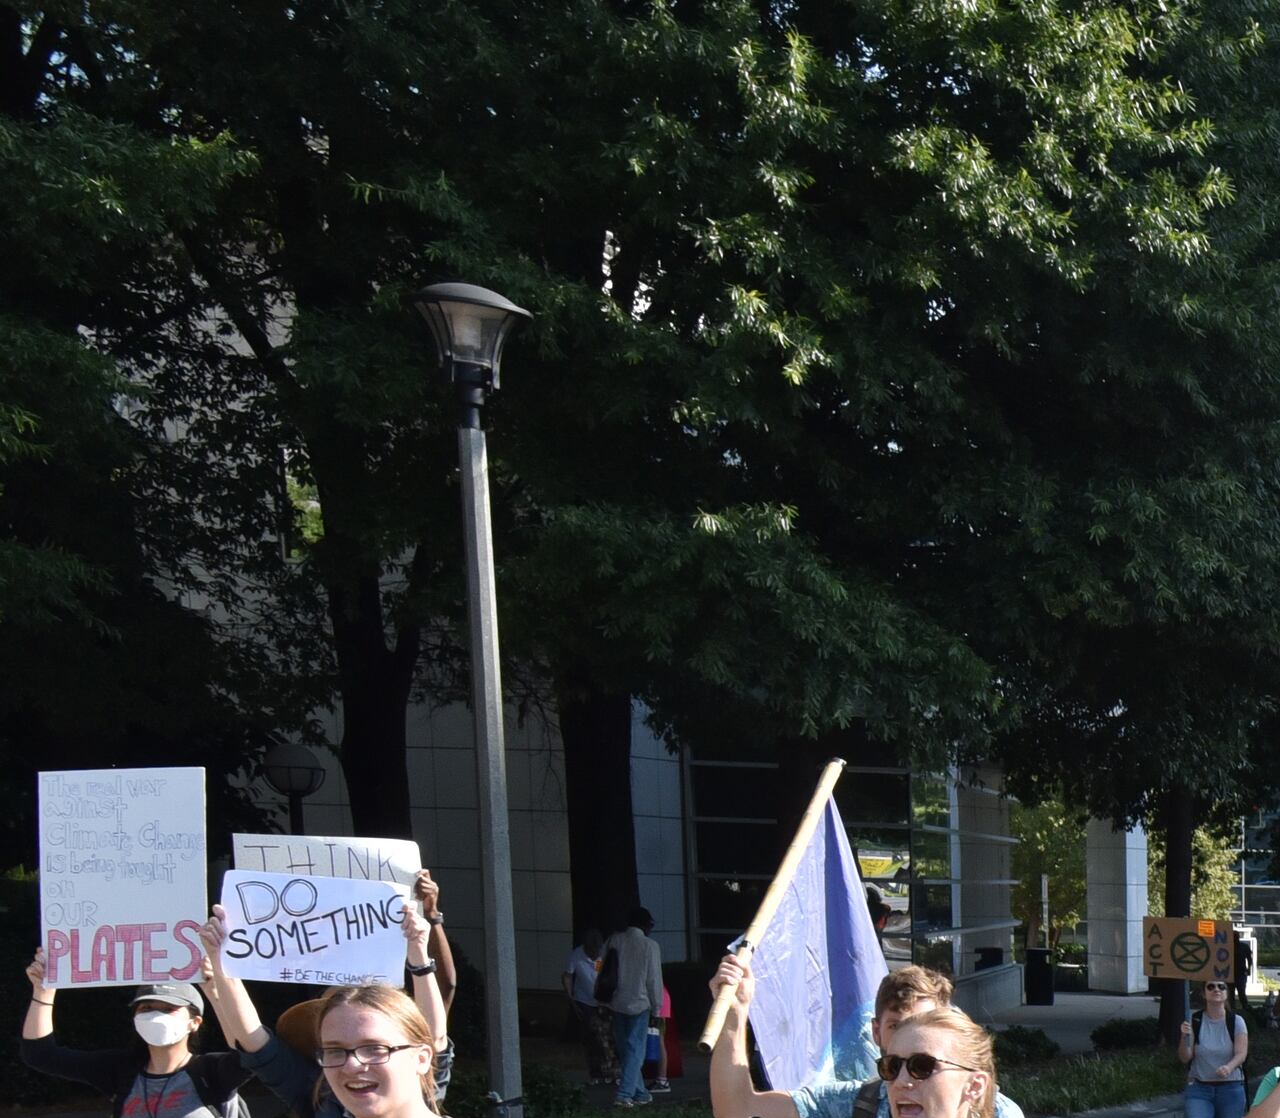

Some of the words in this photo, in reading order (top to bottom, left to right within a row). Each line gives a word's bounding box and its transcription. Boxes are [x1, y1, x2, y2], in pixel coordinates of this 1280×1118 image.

[244, 843, 397, 882] THINK
[46, 900, 98, 927] OUR
[236, 878, 318, 925] DO
[226, 894, 407, 959] SOMETHING
[48, 920, 203, 983] PLATES
